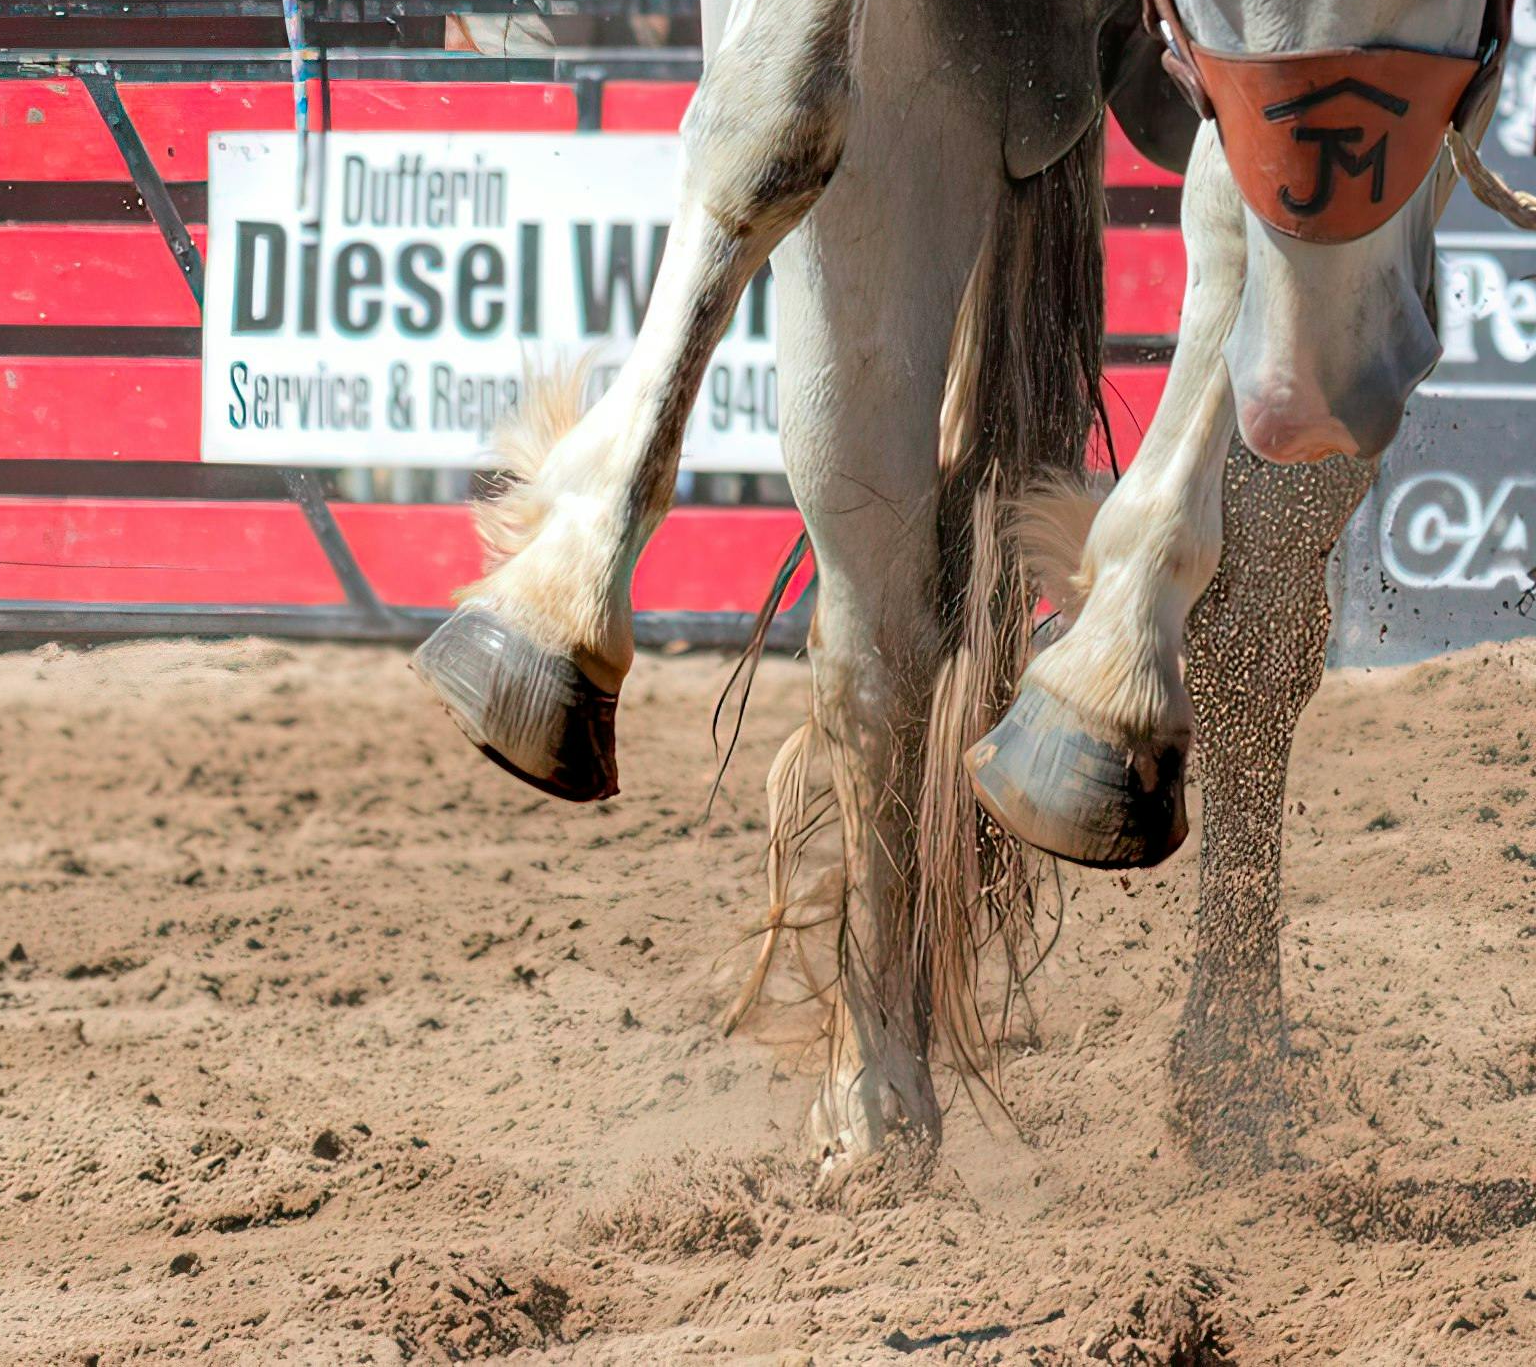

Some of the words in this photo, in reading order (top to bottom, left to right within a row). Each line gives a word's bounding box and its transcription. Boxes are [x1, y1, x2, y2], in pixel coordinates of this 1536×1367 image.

[343, 154, 507, 227] Dufferin
[231, 218, 543, 339] Diesel
[229, 361, 371, 431] Service
[386, 361, 415, 432] &
[430, 361, 521, 440] Repa
